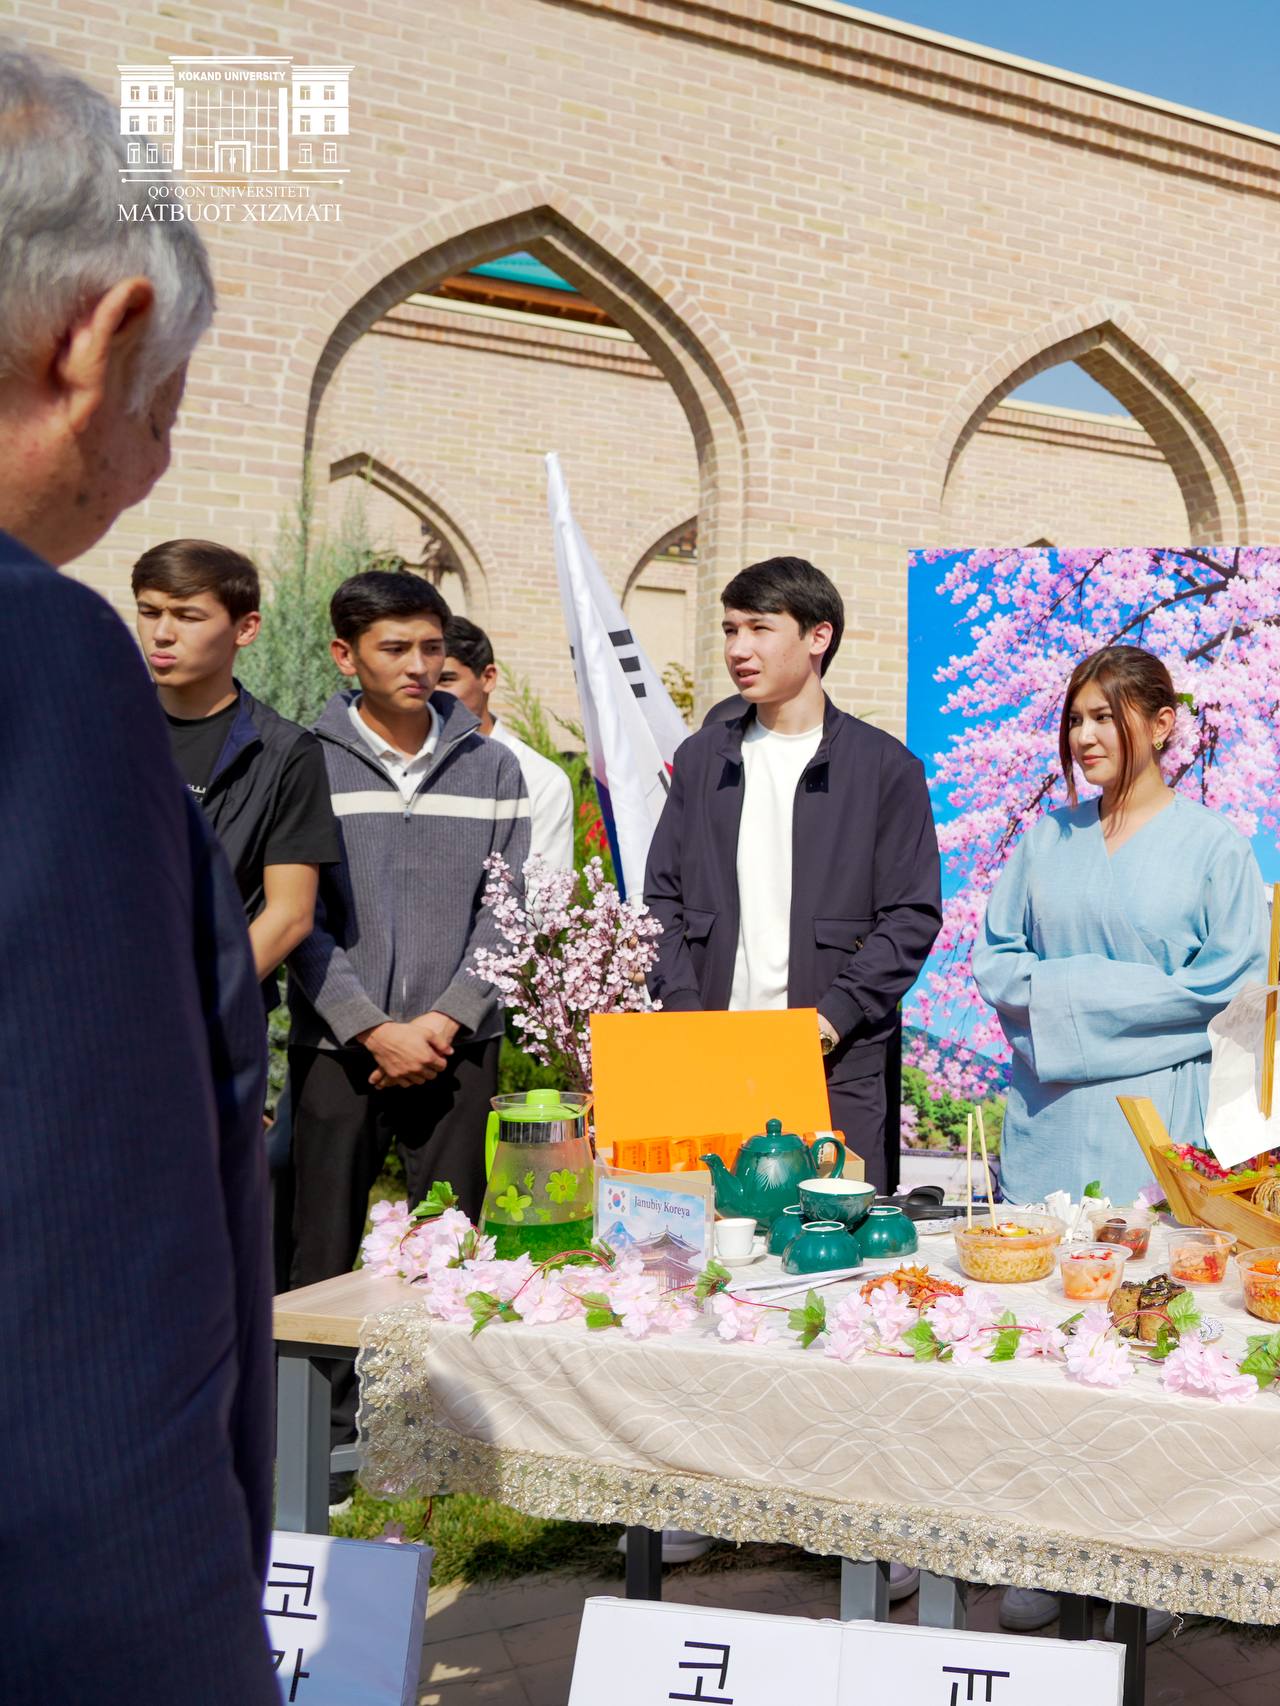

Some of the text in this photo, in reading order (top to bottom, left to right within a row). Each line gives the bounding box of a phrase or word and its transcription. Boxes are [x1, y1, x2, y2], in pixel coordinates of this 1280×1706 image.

[634, 1196, 690, 1219] Janubiy Koreya
[668, 1641, 734, 1705] 코
